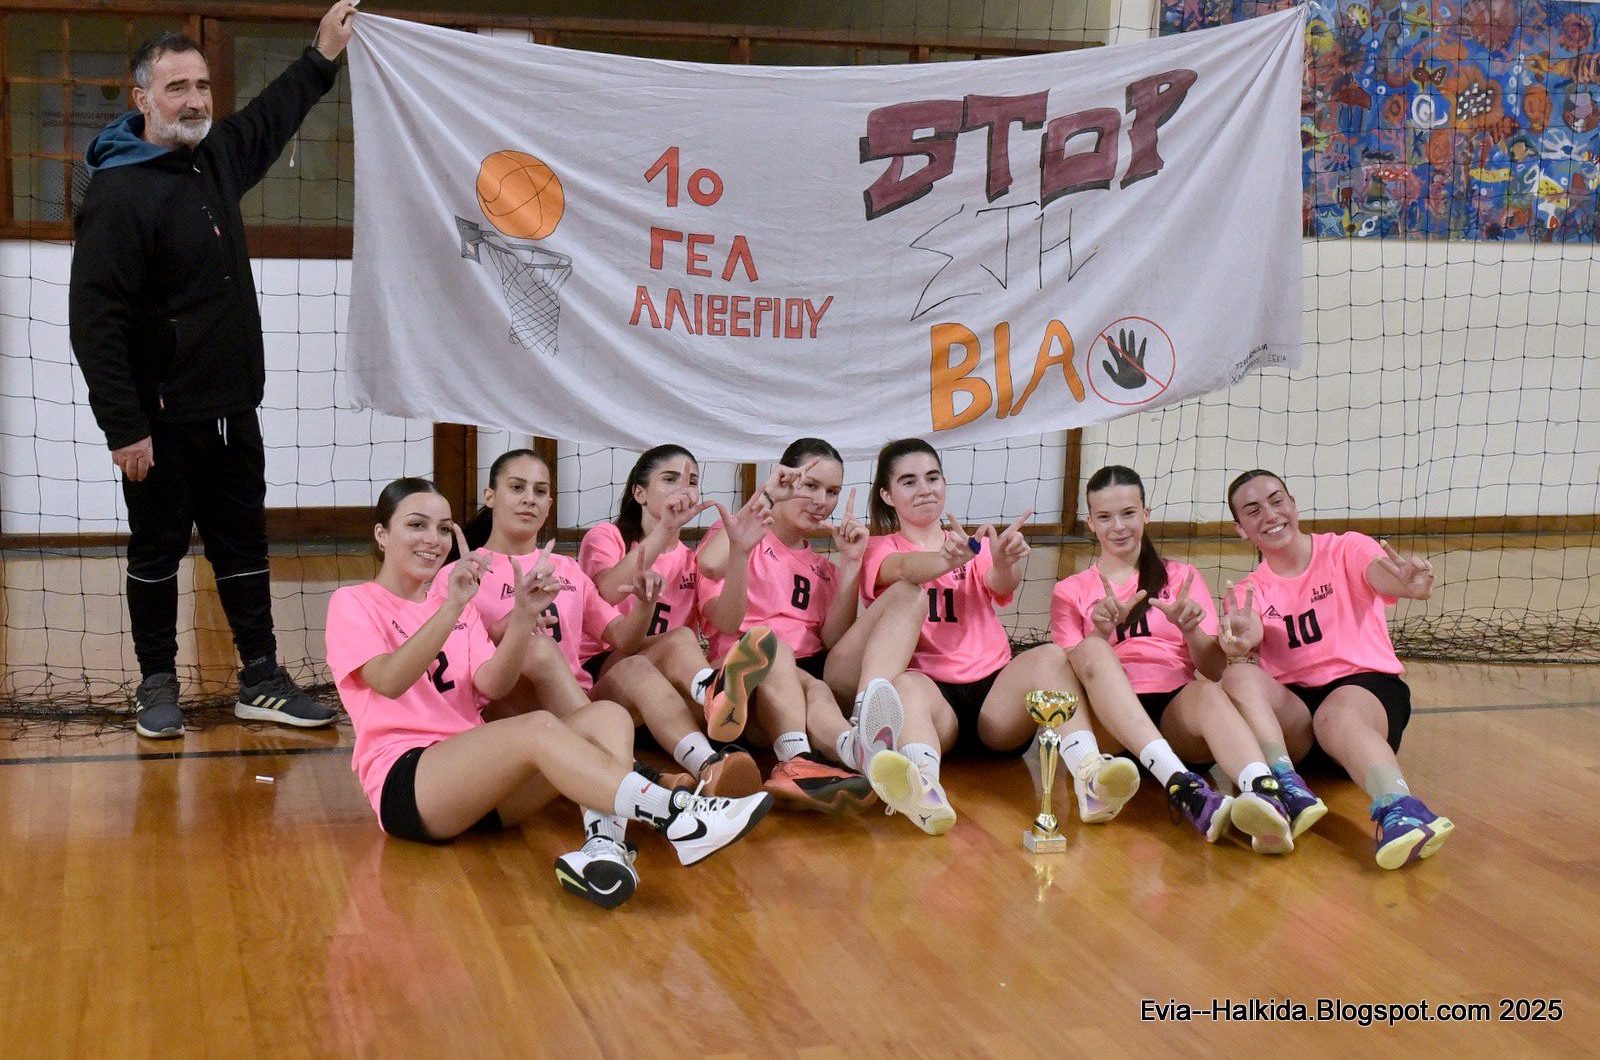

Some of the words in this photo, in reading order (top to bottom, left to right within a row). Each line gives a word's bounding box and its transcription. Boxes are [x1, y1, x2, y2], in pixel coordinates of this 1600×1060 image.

[859, 69, 1198, 221] STOP
[650, 226, 758, 282] ΓΕΛ
[629, 285, 834, 339] ΑΛΙΒΕΡΙΟΥ
[930, 319, 1085, 433] ΒΙΑ
[791, 573, 811, 610] 8
[927, 587, 958, 623] 11
[647, 601, 671, 636] 6
[1283, 608, 1323, 649] 10
